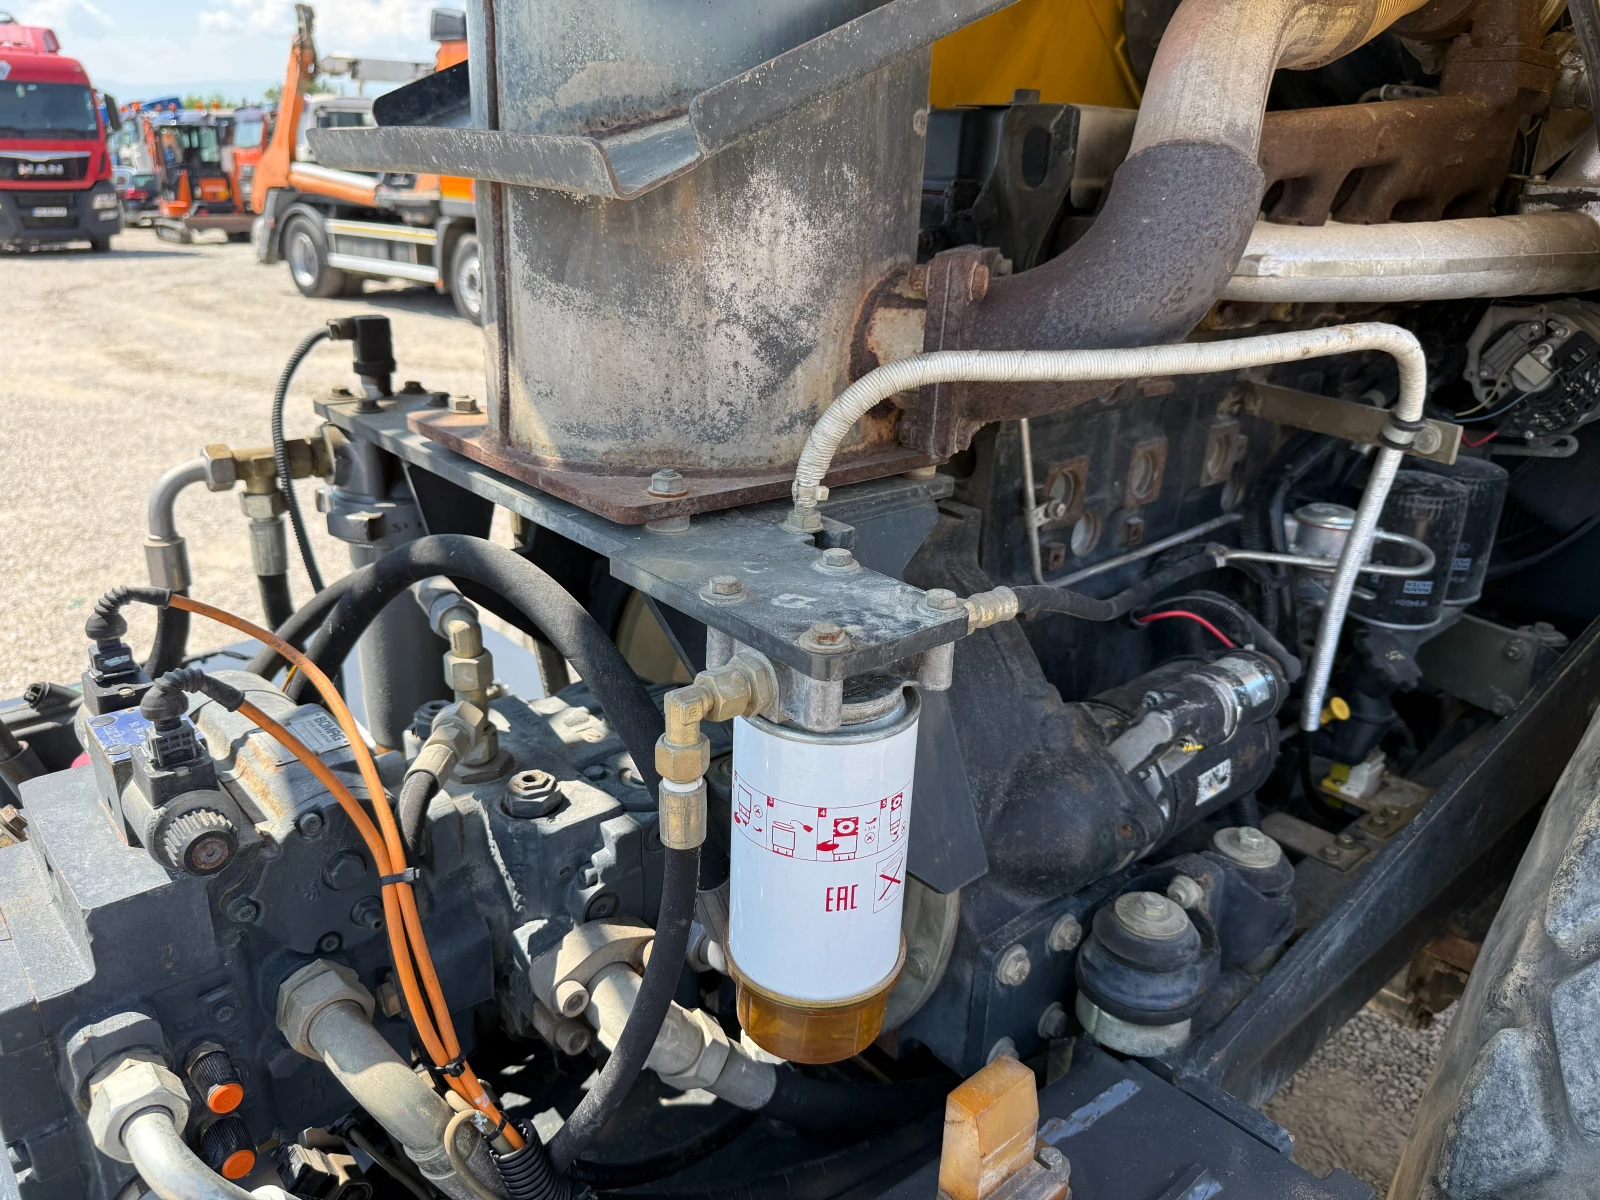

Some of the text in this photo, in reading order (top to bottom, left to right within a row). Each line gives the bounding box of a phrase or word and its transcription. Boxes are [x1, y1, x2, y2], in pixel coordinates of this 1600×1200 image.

[18, 163, 64, 176] MAN
[313, 716, 346, 741] BOMAG
[825, 884, 859, 912] EAC
